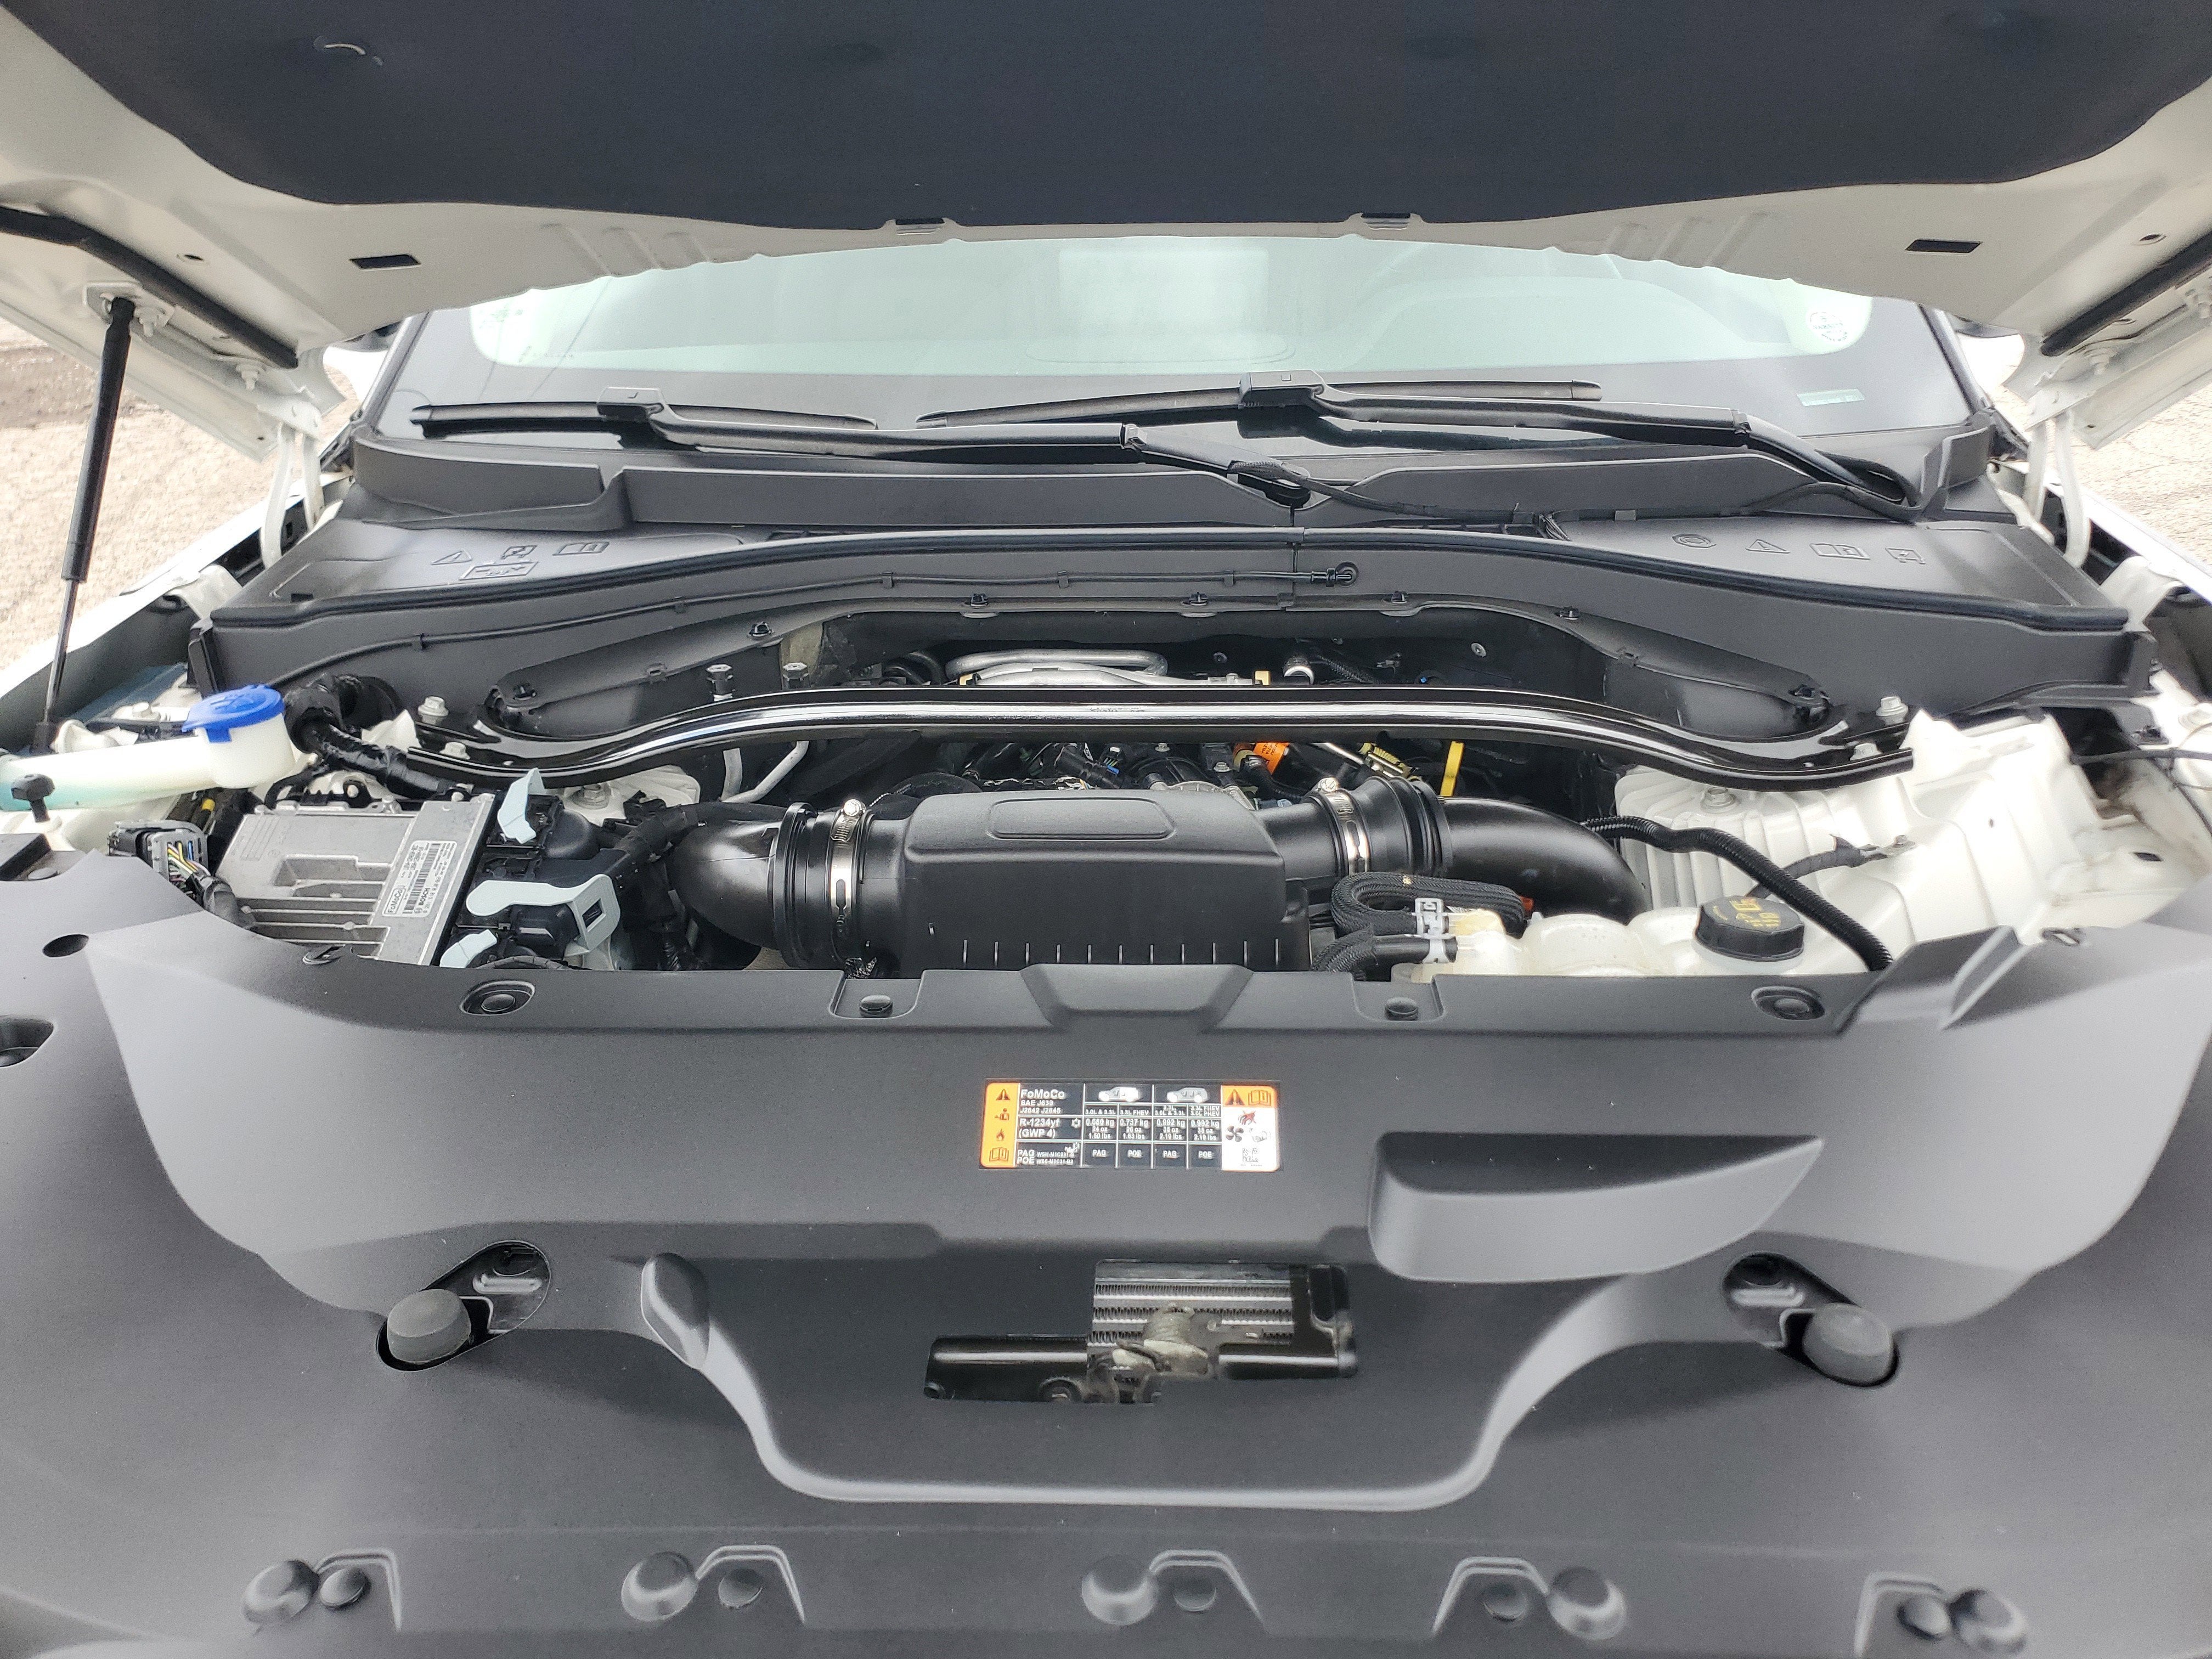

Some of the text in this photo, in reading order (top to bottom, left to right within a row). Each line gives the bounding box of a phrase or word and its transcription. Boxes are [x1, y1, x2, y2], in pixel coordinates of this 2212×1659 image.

[418, 888, 430, 905] BOSCH
[1020, 1089, 1065, 1098] FoMoCo
[1019, 1118, 1060, 1128] R-1234yf
[1105, 1119, 1114, 1128] kg
[1139, 1119, 1149, 1128] kg
[1176, 1119, 1185, 1128] kg
[1211, 1120, 1220, 1130] kg
[1019, 1129, 1056, 1138] (GWP 4)
[1127, 1149, 1142, 1158] POE
